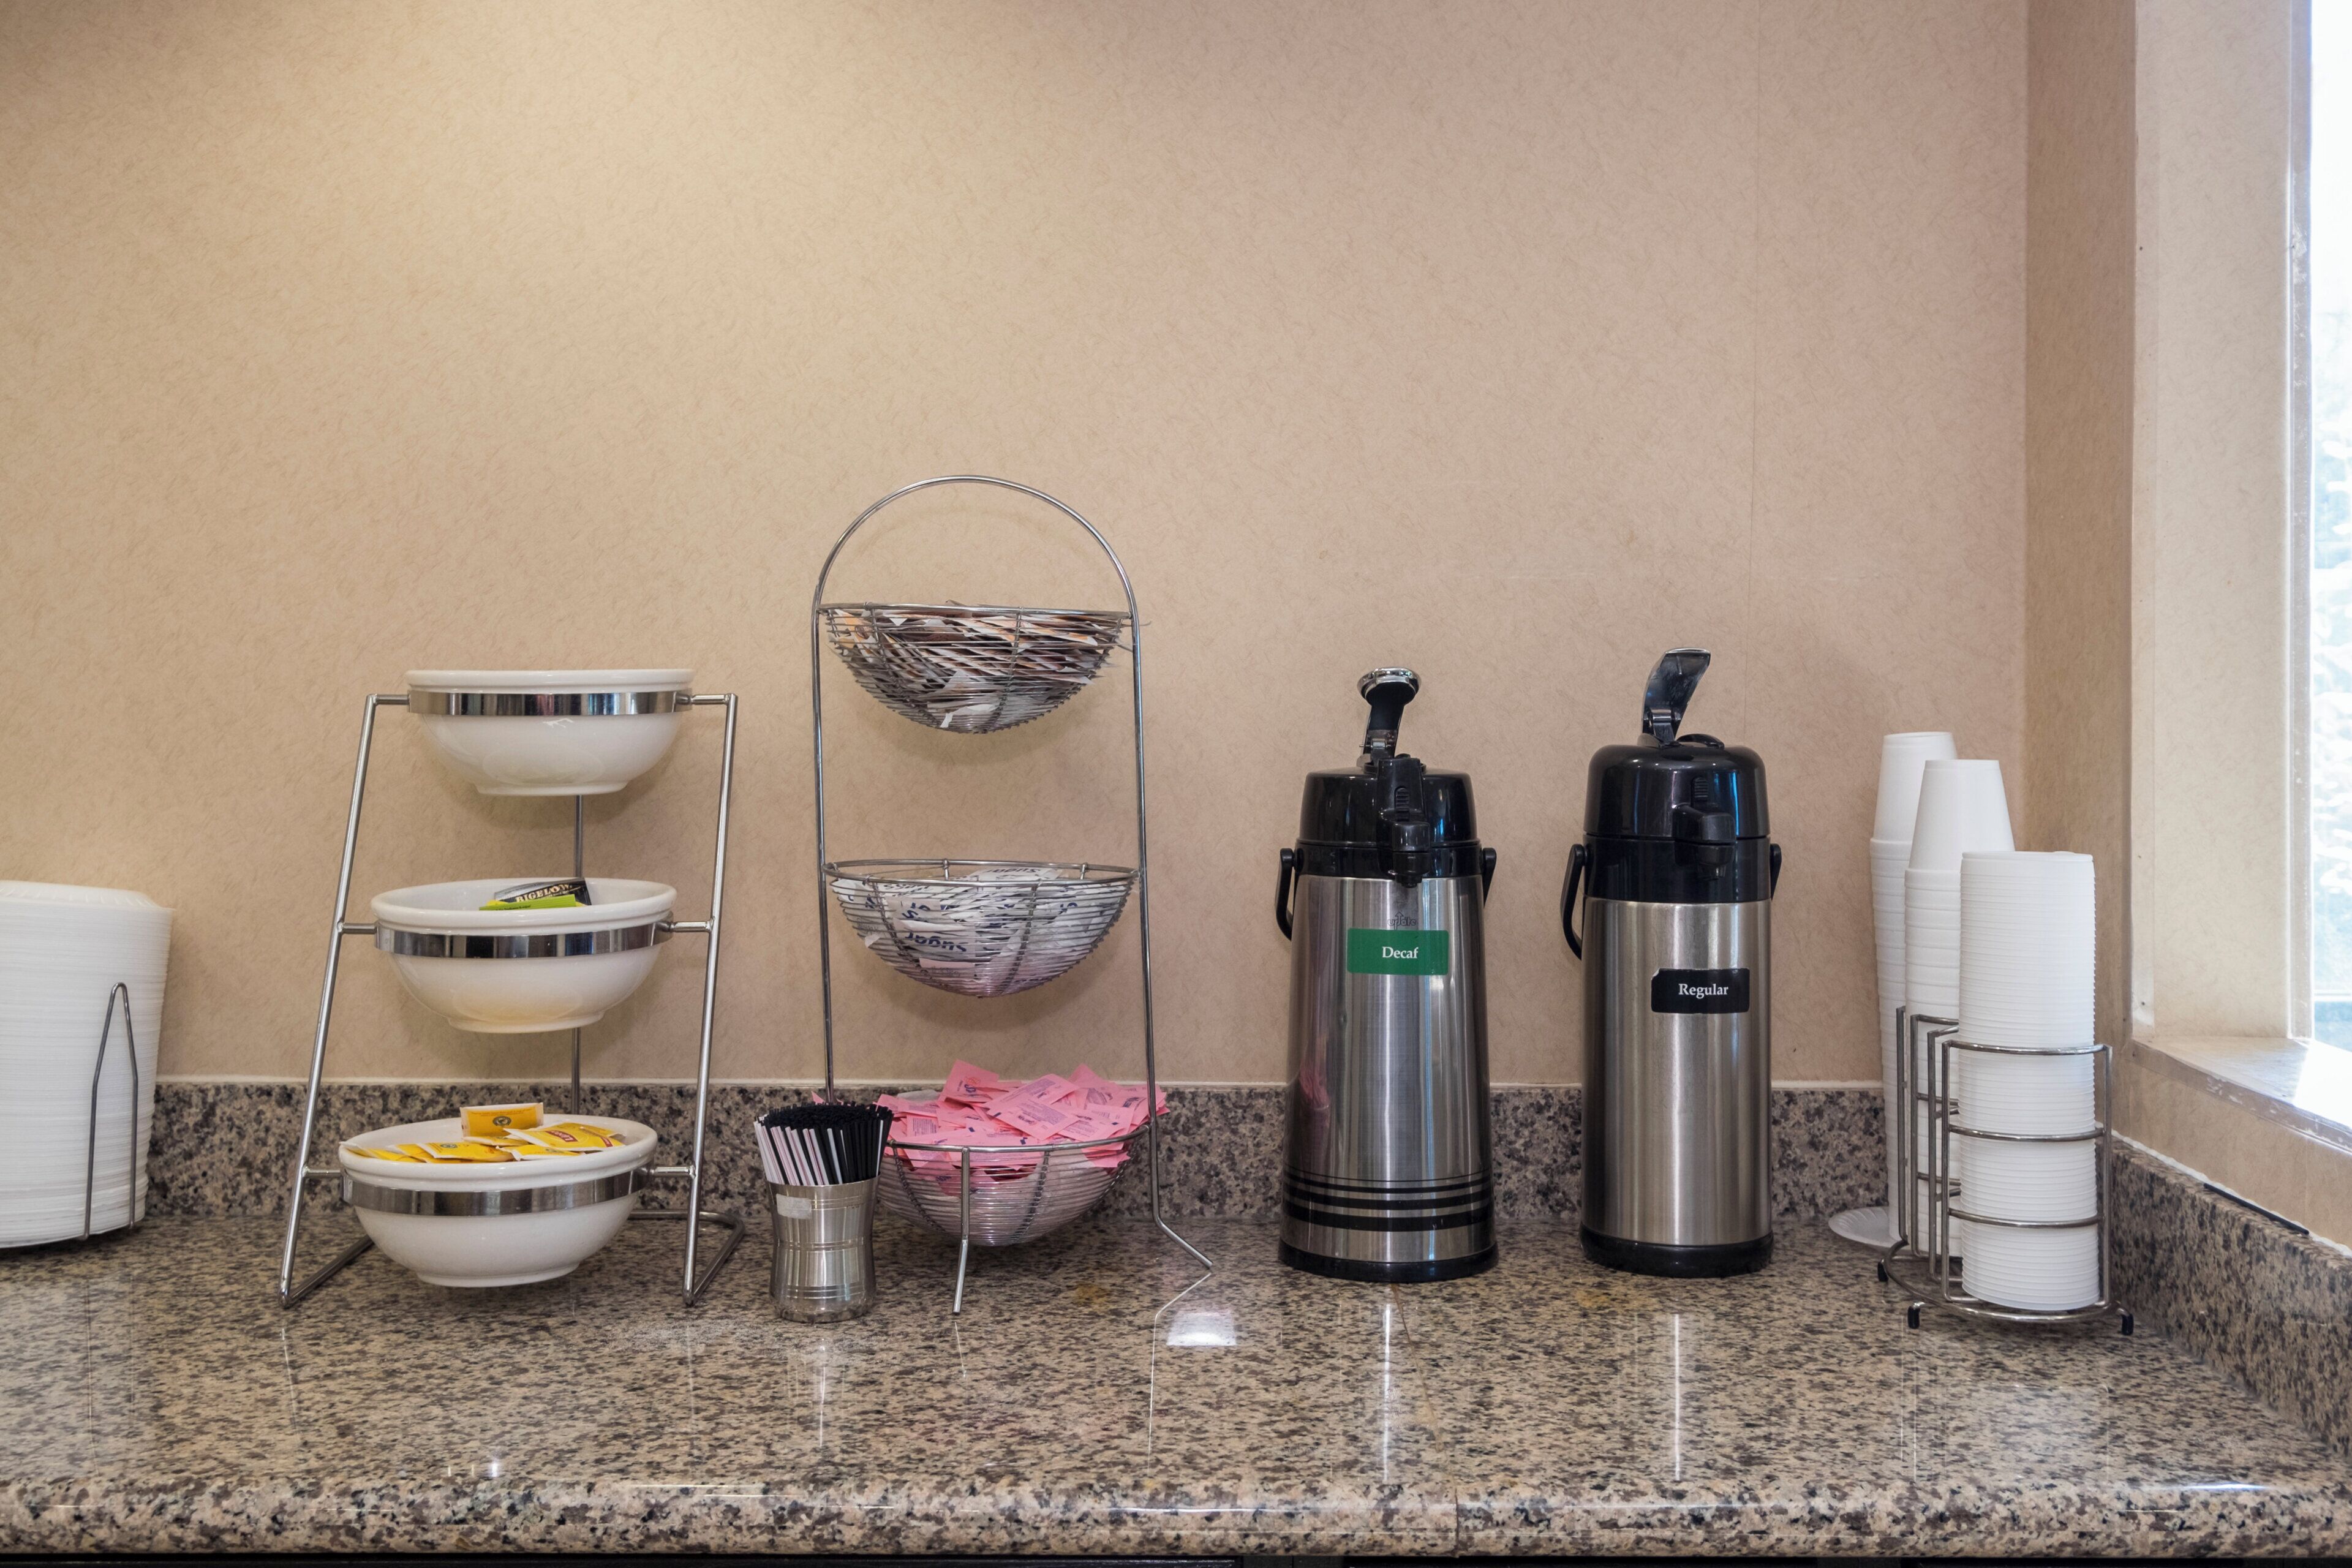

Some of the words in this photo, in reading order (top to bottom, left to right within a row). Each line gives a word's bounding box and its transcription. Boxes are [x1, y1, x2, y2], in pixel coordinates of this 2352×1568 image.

[515, 884, 570, 903] BIGELOW
[1382, 946, 1419, 959] Decaf
[1678, 983, 1728, 999] Regular
